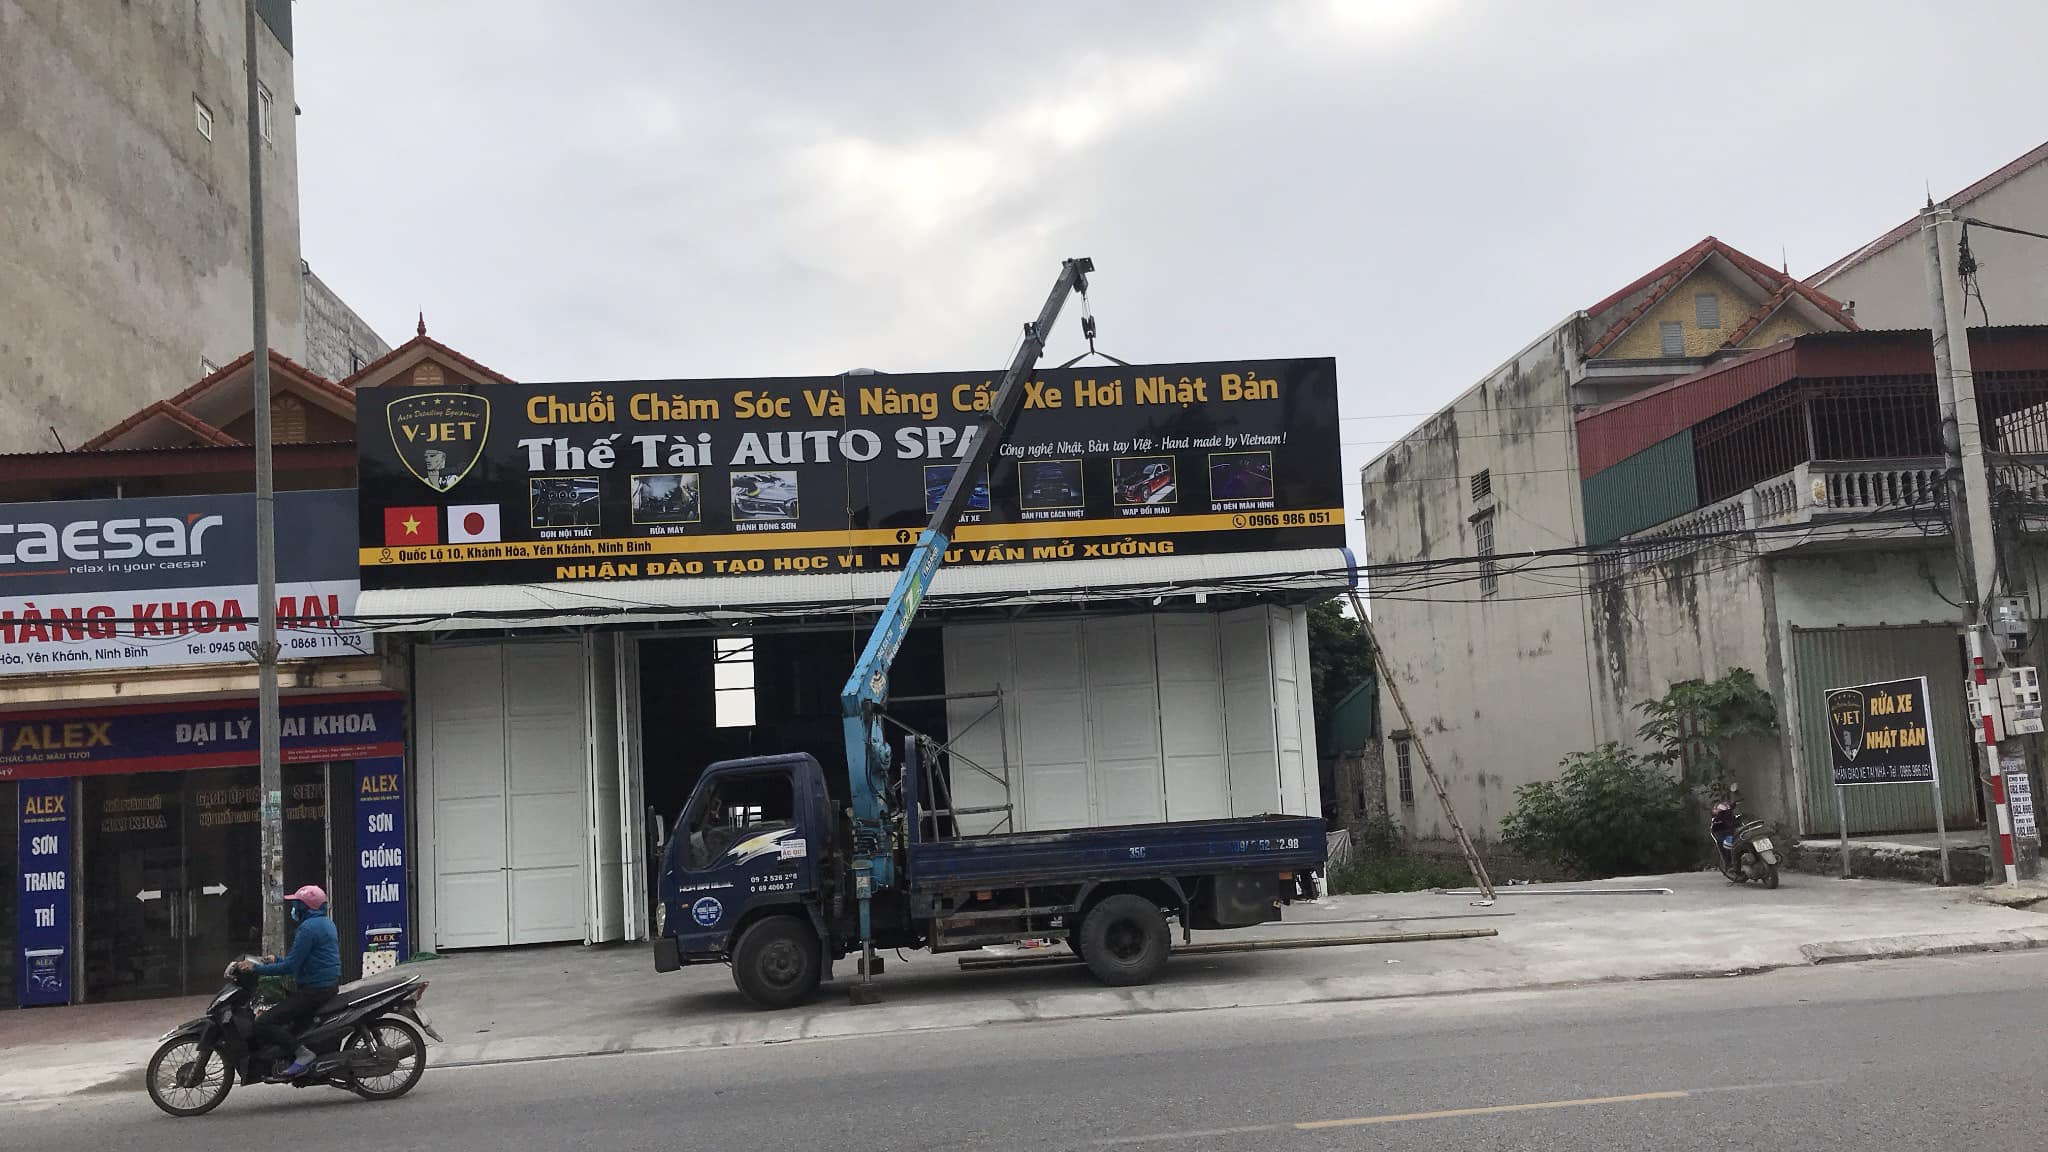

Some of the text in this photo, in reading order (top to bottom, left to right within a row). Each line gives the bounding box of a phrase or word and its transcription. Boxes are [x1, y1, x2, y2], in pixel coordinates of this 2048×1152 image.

[527, 372, 1279, 424] Chuỗi Chăm Sóc Và Nâng Cấ Xe Hơi Nhật Bản
[401, 421, 476, 443] V-JET
[518, 433, 623, 472] Thế
[632, 432, 713, 468] Tài
[729, 429, 882, 466] AUTO
[999, 443, 1025, 458] Công
[1028, 441, 1053, 458] nghệ
[1056, 440, 1085, 456] Nhật,
[1113, 441, 1129, 454] tay
[1132, 438, 1152, 453] Việt
[1161, 436, 1189, 449] Hand
[1192, 435, 1222, 447] made
[1225, 434, 1237, 448] by
[781, 520, 797, 531] SƠN
[971, 514, 981, 522] XE
[1035, 511, 1050, 520] FILM
[1249, 511, 1331, 527] 0966 986 051
[574, 527, 592, 538] THẤT
[667, 525, 684, 535] MÁY
[398, 540, 652, 564] Quốc Lộ 10, Khánh Hòa, Yên Khánh, Ninh Bình
[555, 562, 638, 580] NHẬN
[647, 558, 704, 576] ĐÀO
[712, 556, 766, 575] TẠO
[773, 554, 829, 572] HỌC
[965, 544, 1026, 563] VẤN
[1032, 539, 1075, 559] MỞ
[1083, 537, 1174, 556] XƯỞNG
[69, 563, 104, 575] relax
[107, 562, 120, 572] in
[123, 562, 156, 574] your
[132, 599, 247, 637] KHOA
[26, 652, 49, 664] Yên
[52, 648, 92, 662] Khánh,
[95, 647, 121, 660] Ninh
[124, 645, 149, 659] Bình
[187, 643, 206, 655] Tel:
[209, 641, 235, 654] 0945
[291, 637, 317, 650] 0868
[321, 636, 338, 648] 111
[1870, 690, 1913, 716] RỬA XE
[175, 712, 377, 746] ĐẠI LÝ AI KHOA
[1833, 710, 1860, 726] V-JET
[12, 722, 113, 753] ALEX
[1865, 721, 1926, 754] NHẬT BẢN
[361, 774, 399, 793] ALEX
[25, 795, 66, 815] ALEX
[368, 812, 394, 833] SƠN
[31, 833, 58, 856] SƠN
[361, 843, 403, 869] CHỐNG
[24, 871, 66, 892] TRANG
[365, 878, 400, 904] THẤM
[34, 904, 56, 928] TRÍ
